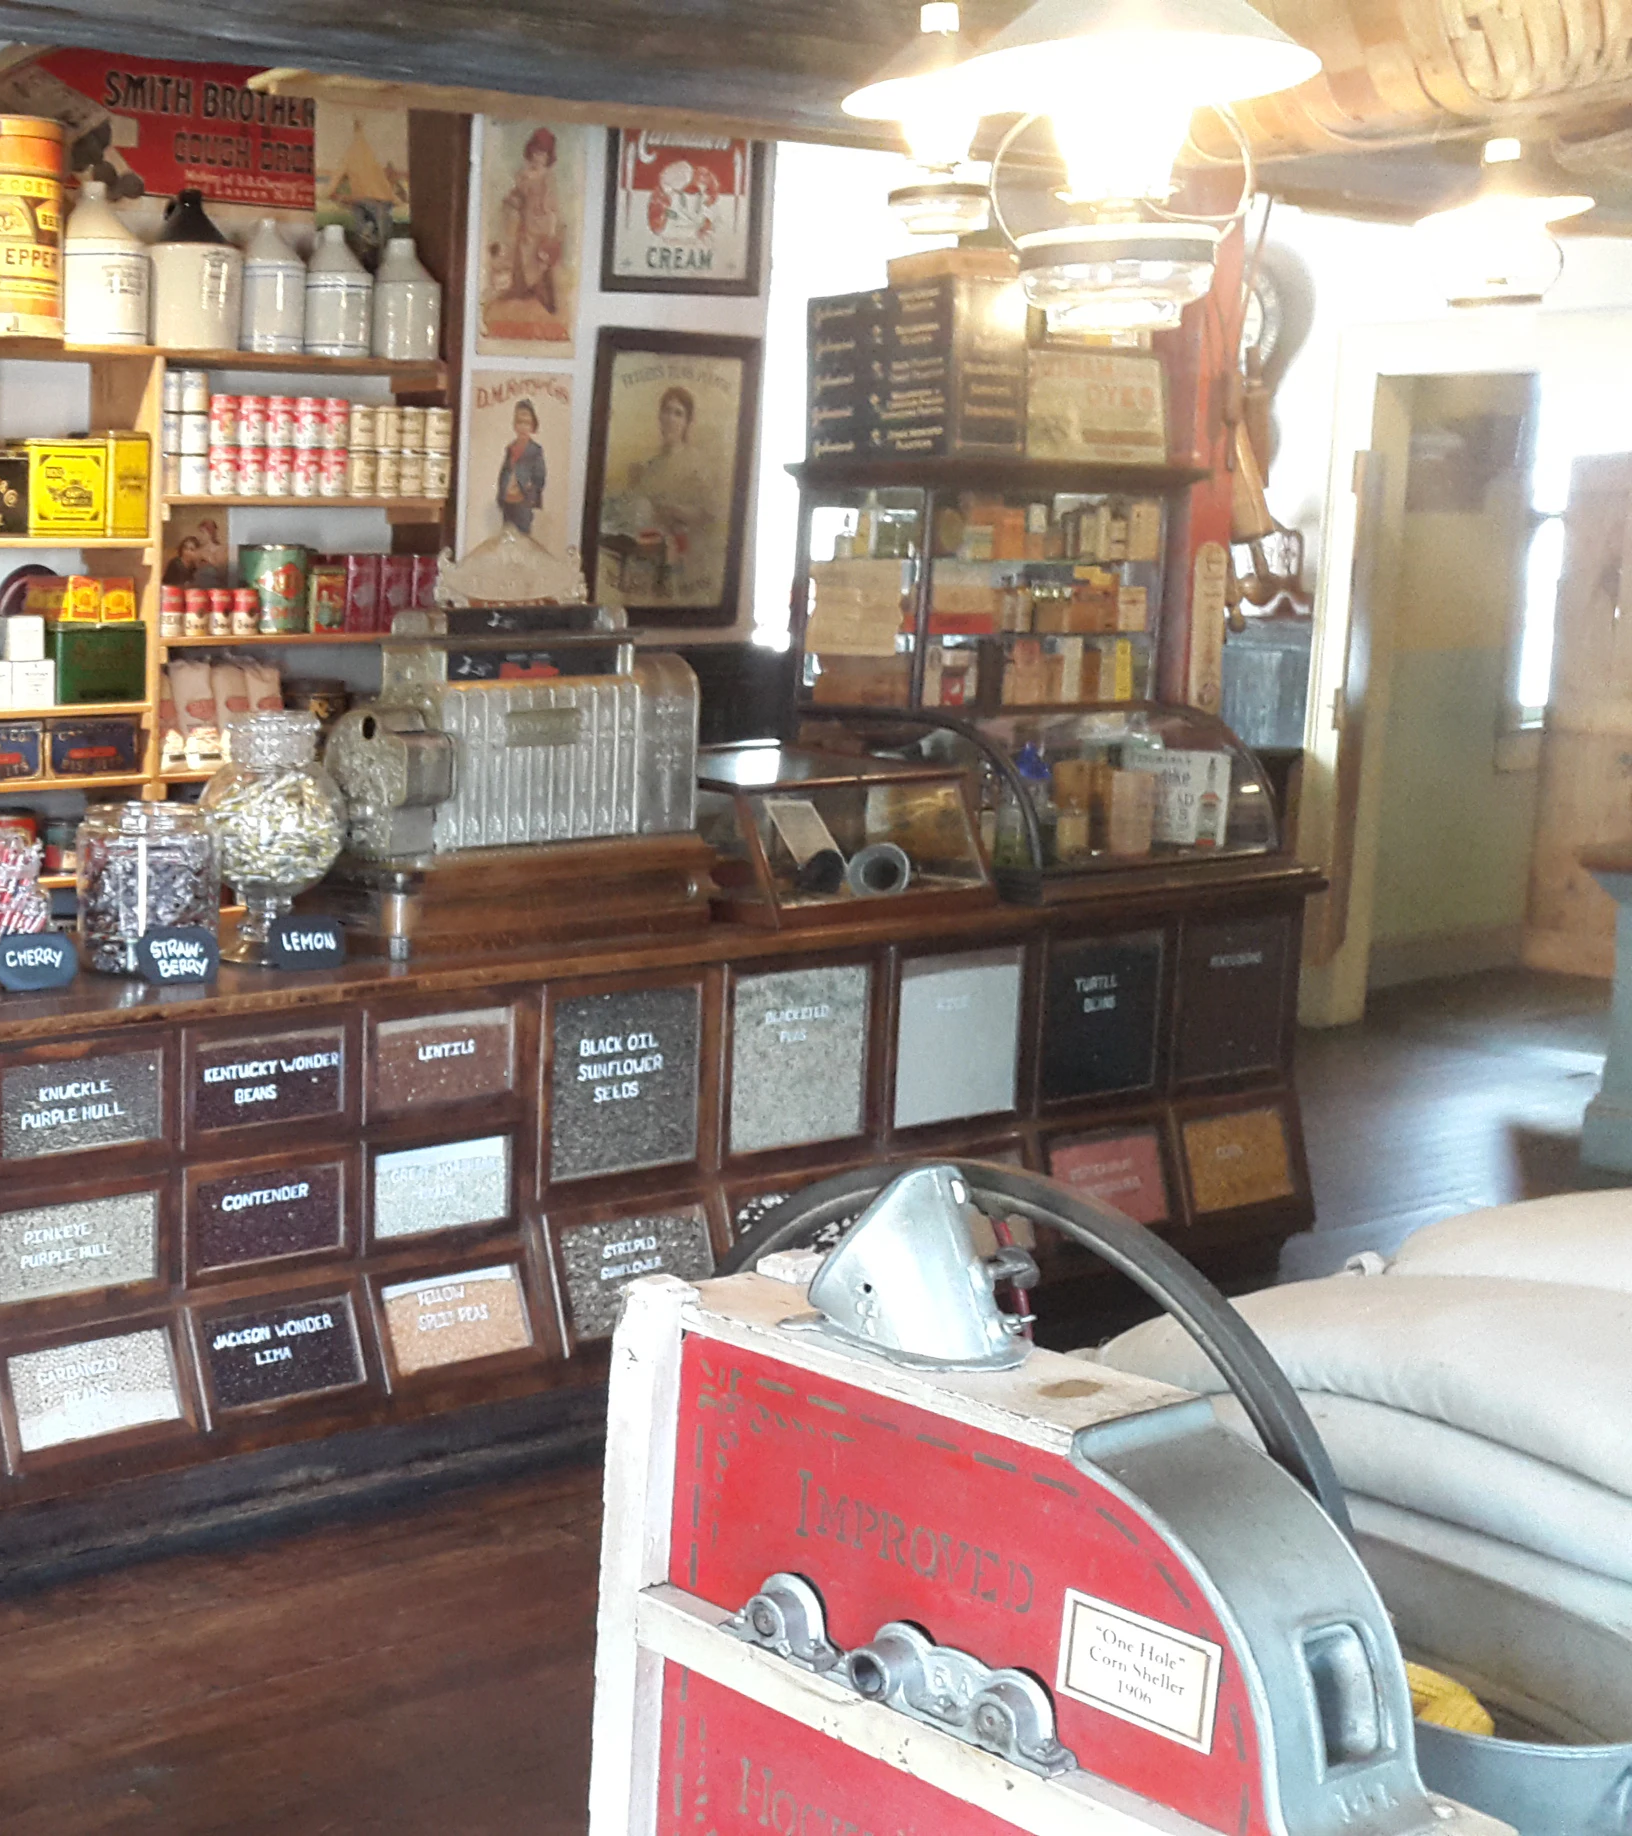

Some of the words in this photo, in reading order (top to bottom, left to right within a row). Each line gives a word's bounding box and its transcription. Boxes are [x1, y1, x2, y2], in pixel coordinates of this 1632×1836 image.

[104, 69, 193, 115] SMITH
[174, 130, 253, 169] COUGH
[645, 245, 715, 270] CREAM
[149, 940, 204, 959] STRAW-
[281, 931, 337, 952] LEMON
[5, 949, 63, 969] CHERRY
[158, 957, 210, 977] BERRY
[417, 1038, 476, 1062] LENTILS
[579, 1036, 624, 1059] BLACK
[626, 1031, 659, 1052] OIL
[203, 1059, 279, 1085] KENTUCKY
[280, 1051, 340, 1074] WONDER
[576, 1053, 665, 1083] SUNFLOWER
[38, 1078, 113, 1103] KNUCKLE
[234, 1083, 278, 1105] BEANS
[592, 1080, 640, 1105] SEEDS
[20, 1107, 79, 1132] PURPLE
[81, 1101, 125, 1122] HULL
[220, 1181, 310, 1213] CONTENDER
[22, 1221, 92, 1247] PINKEYE
[19, 1248, 75, 1271] PURPLE
[78, 1242, 113, 1259] HULL
[416, 1283, 466, 1308] YELLOW
[212, 1324, 271, 1352] JACKSON
[274, 1312, 335, 1339] WONDER
[254, 1345, 294, 1367] LIMA
[794, 1467, 1035, 1615] IMPROVED
[1088, 1644, 1128, 1673] Corn
[1132, 1662, 1186, 1697] Sheller
[1117, 1678, 1153, 1705] 1906
